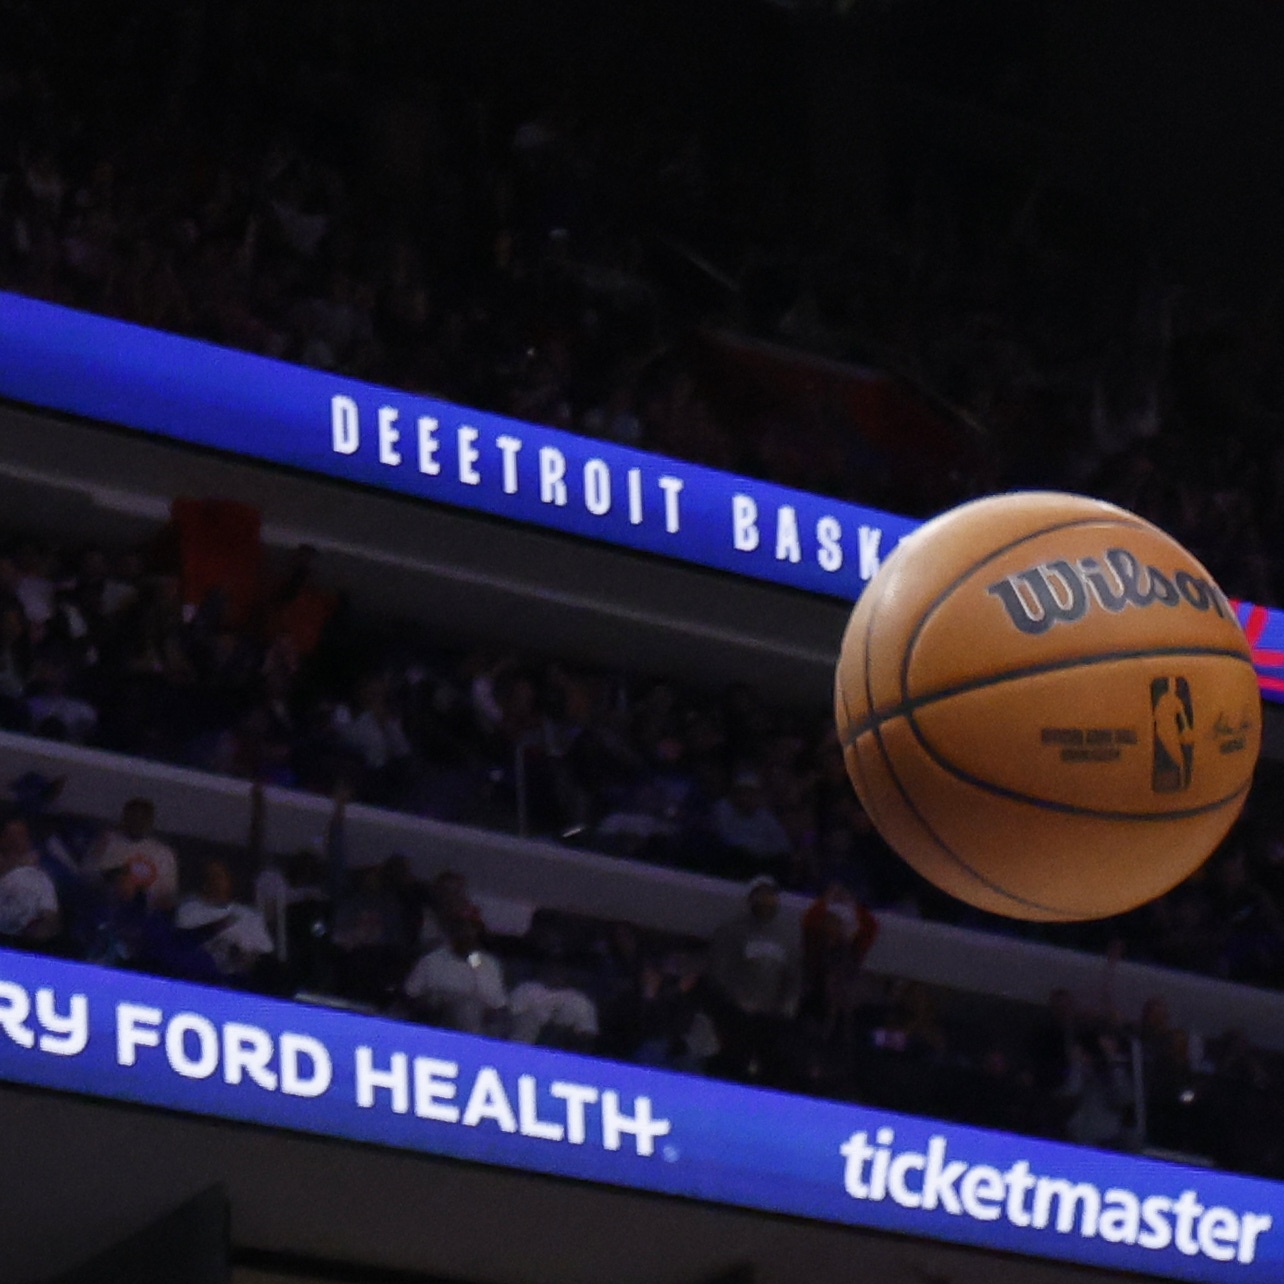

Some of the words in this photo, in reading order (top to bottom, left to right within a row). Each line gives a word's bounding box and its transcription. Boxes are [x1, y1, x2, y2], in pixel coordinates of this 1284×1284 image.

[330, 394, 684, 535] DEEETROIT
[732, 493, 884, 582] BASK
[115, 1001, 333, 1098] FORD
[839, 1126, 1273, 1265] ticketmaster
